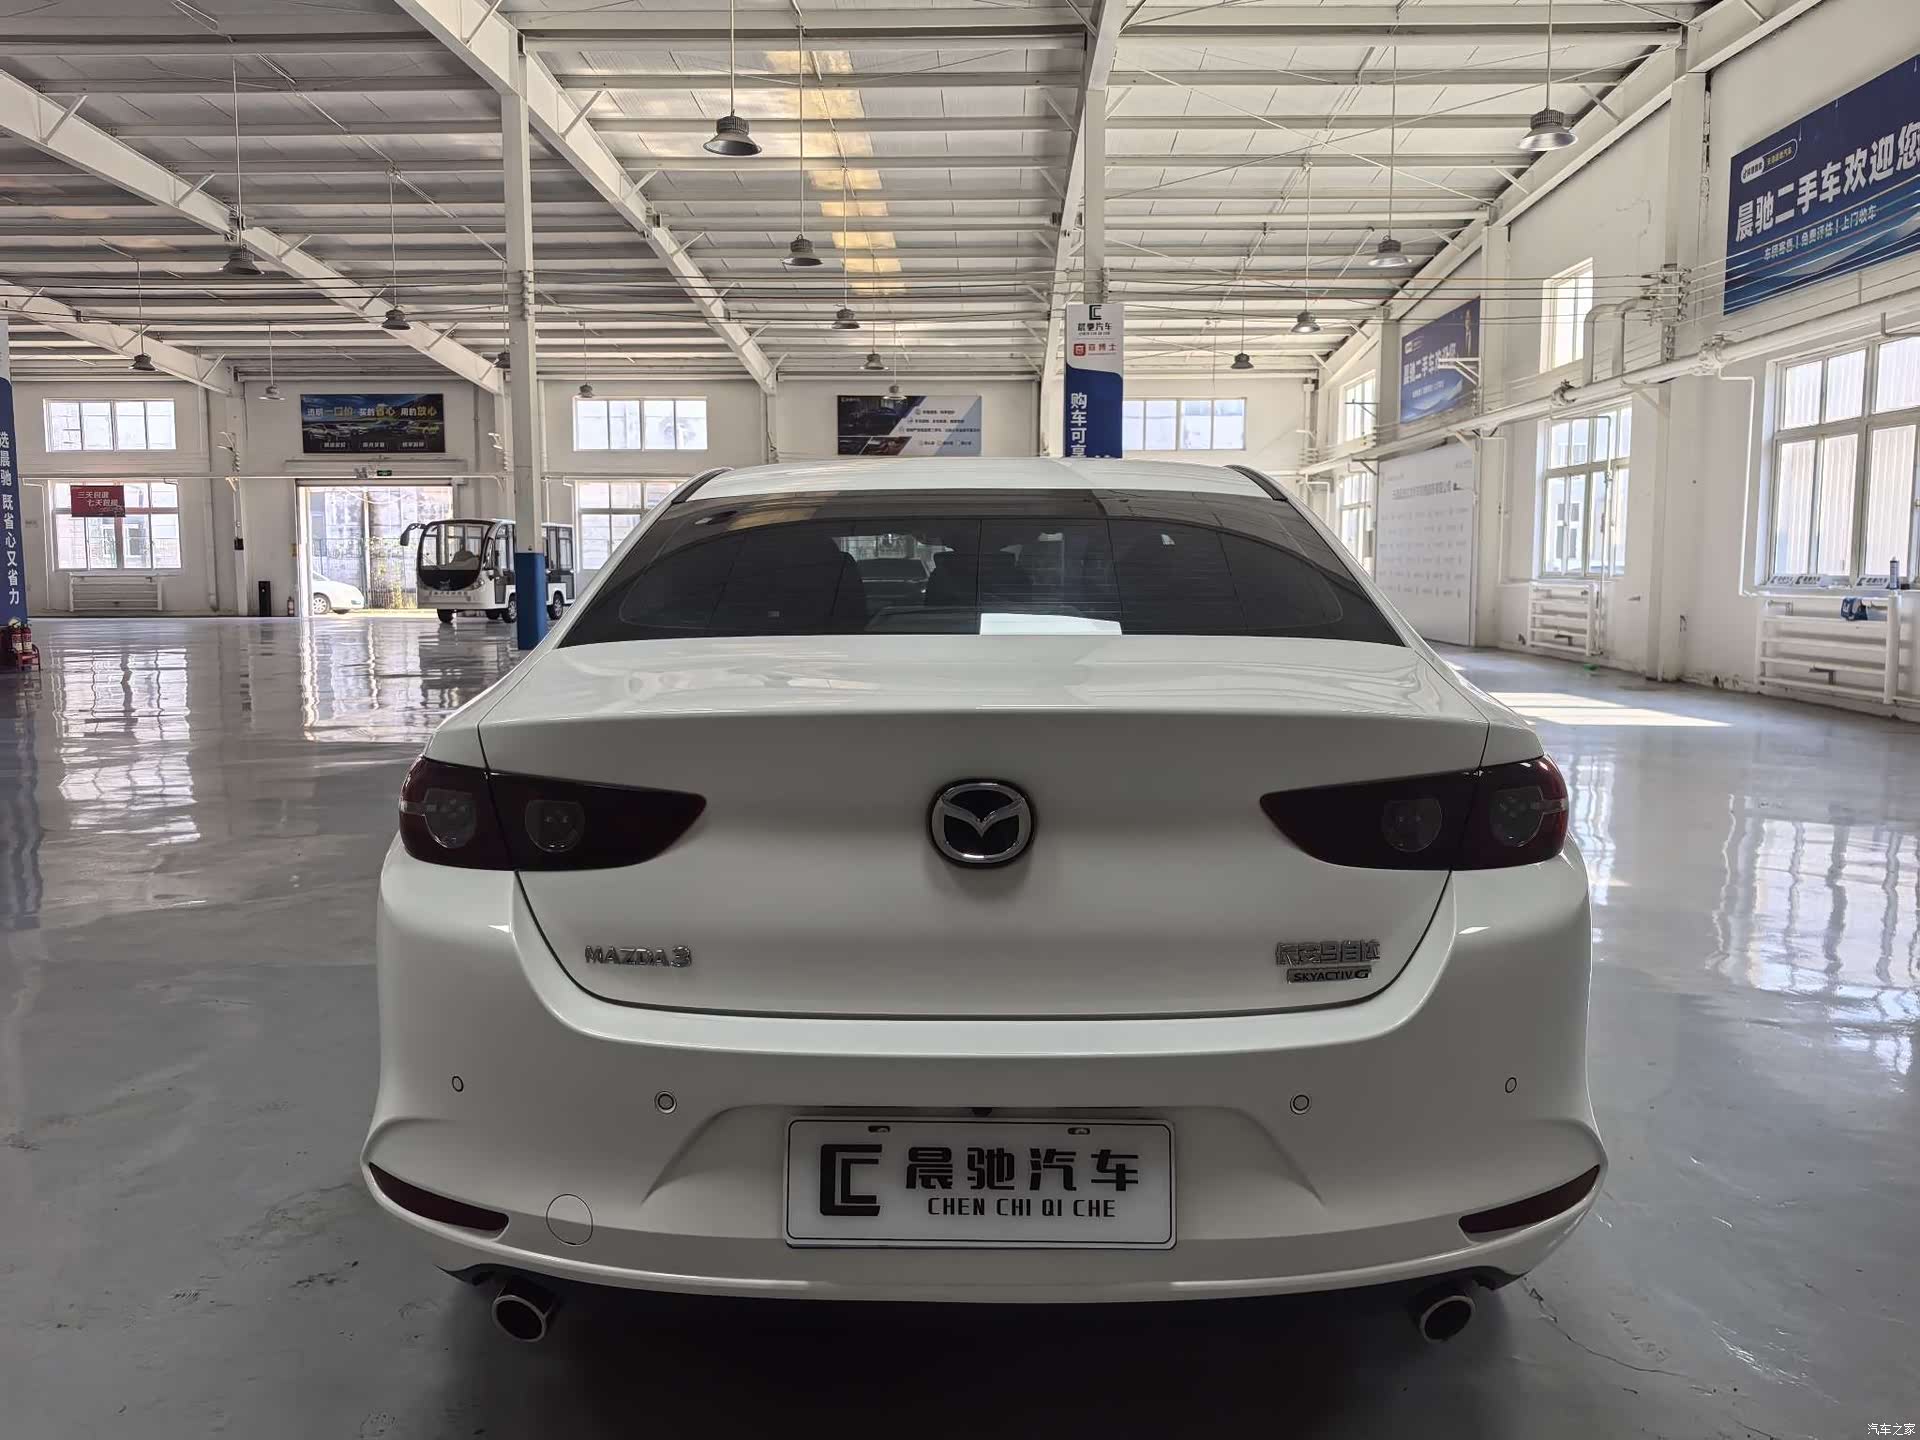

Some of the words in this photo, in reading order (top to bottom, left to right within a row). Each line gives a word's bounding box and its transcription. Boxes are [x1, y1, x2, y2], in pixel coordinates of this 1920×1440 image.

[1736, 122, 1920, 242] 晨驰二手车欢迎您
[3, 494, 20, 605] 既省心又省力
[584, 946, 670, 967] MAZDA
[670, 946, 692, 967] 3
[905, 1146, 1139, 1192] 晨驰汽车
[927, 1197, 986, 1216] CHEN
[996, 1198, 1032, 1217] CHI
[1042, 1198, 1063, 1217] QI
[1073, 1199, 1116, 1218] CHE
